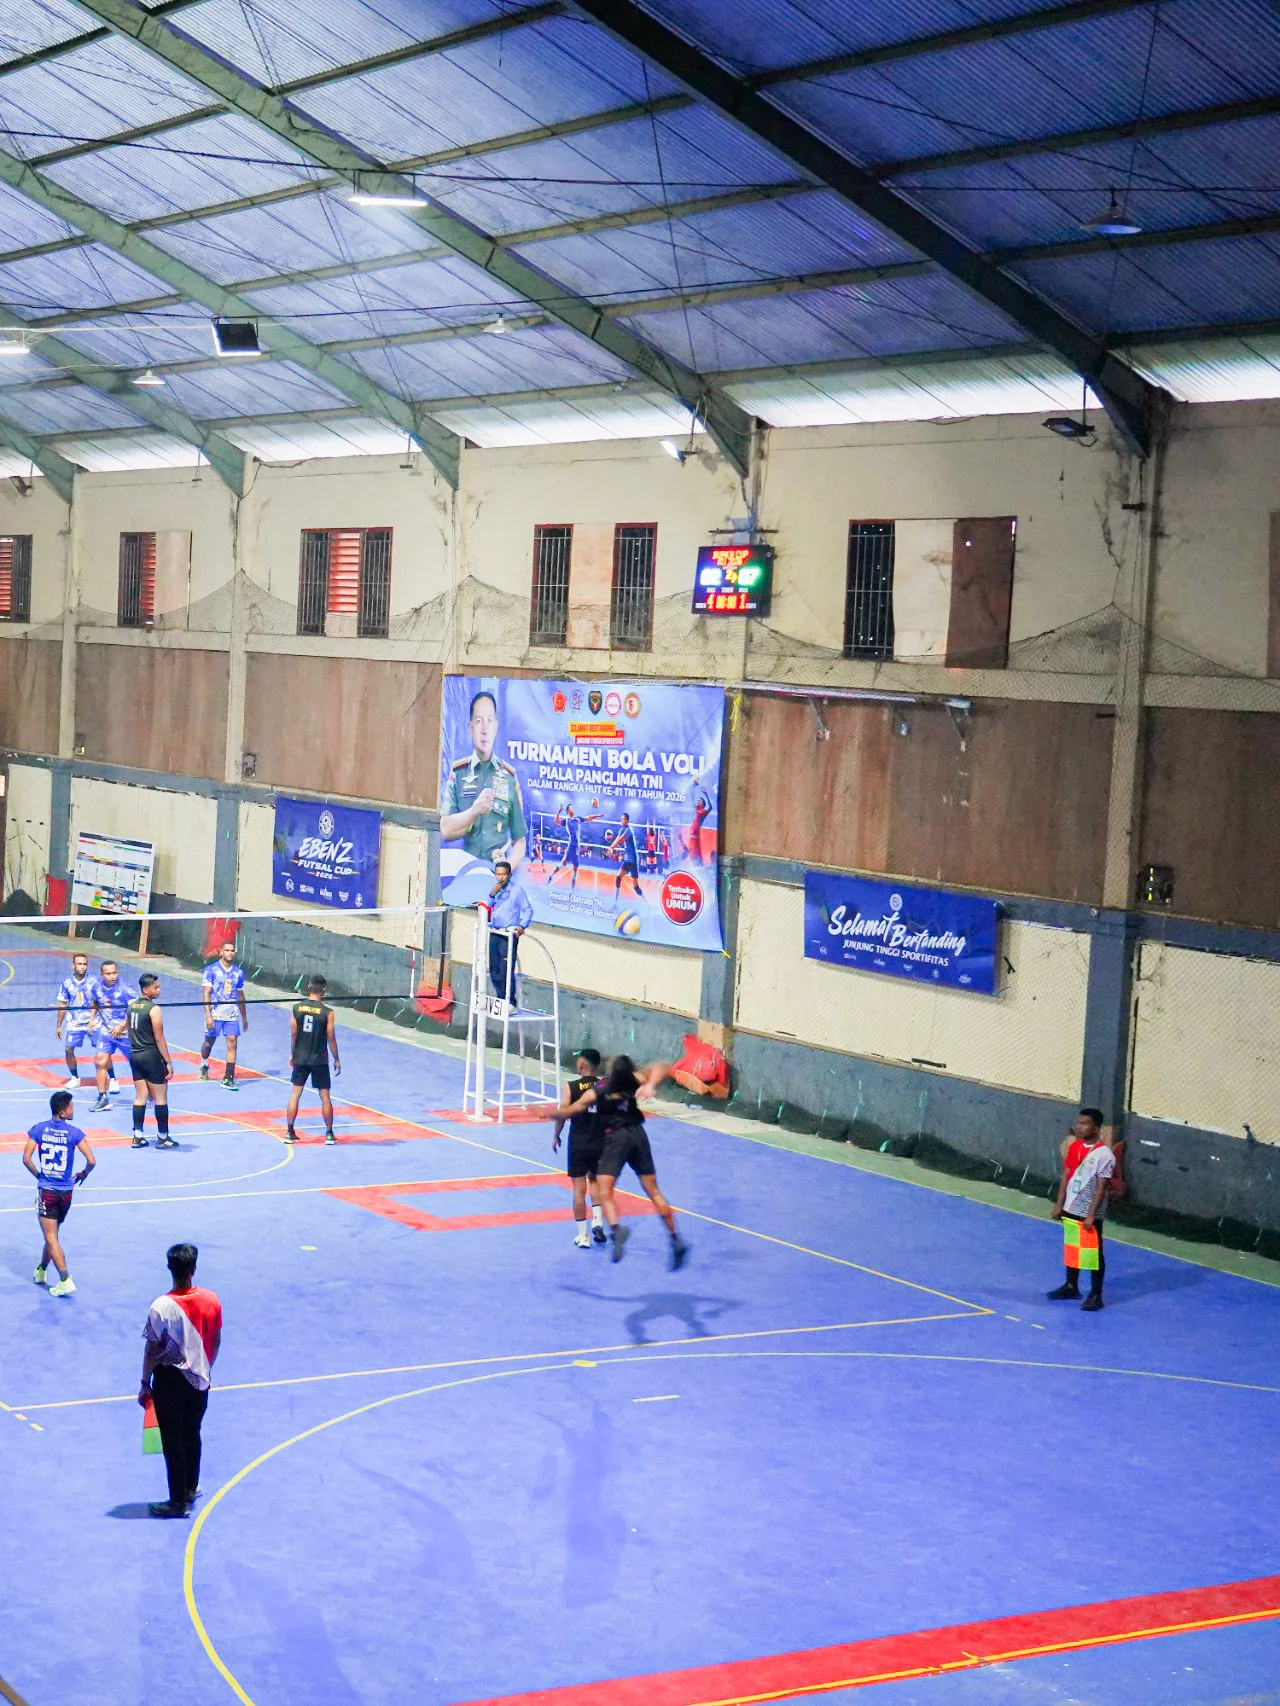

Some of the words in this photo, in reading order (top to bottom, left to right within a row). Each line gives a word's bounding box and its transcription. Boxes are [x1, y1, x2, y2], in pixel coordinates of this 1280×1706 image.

[507, 740, 602, 768] TURNAMEN
[608, 749, 657, 772] BOLA
[660, 752, 705, 776] VOLI
[539, 765, 573, 781] PIALA
[575, 769, 640, 787] PANGLIMA
[641, 774, 663, 789] TNI
[527, 778, 553, 789] DALAM
[554, 780, 585, 793] RANGKA
[586, 785, 602, 794] HUT
[603, 786, 622, 797] KE-81
[624, 788, 637, 798] TNI
[637, 789, 665, 800] TAHUN
[665, 791, 686, 802] 2026
[298, 859, 332, 873] FUTSAL
[334, 865, 353, 876] CUP
[315, 872, 333, 880] 2026
[668, 884, 695, 894] Terbuka
[670, 893, 691, 902] Untuk
[666, 900, 696, 912] UMUM
[828, 905, 900, 943] Selamat
[889, 924, 967, 956] Bertanding
[843, 939, 874, 953] JUNJUNG
[876, 945, 899, 958] TINGGI
[901, 950, 949, 967] SPORTIFITAS
[130, 1012, 139, 1030] 11
[303, 1014, 313, 1032] 6
[41, 1142, 68, 1171] 23
